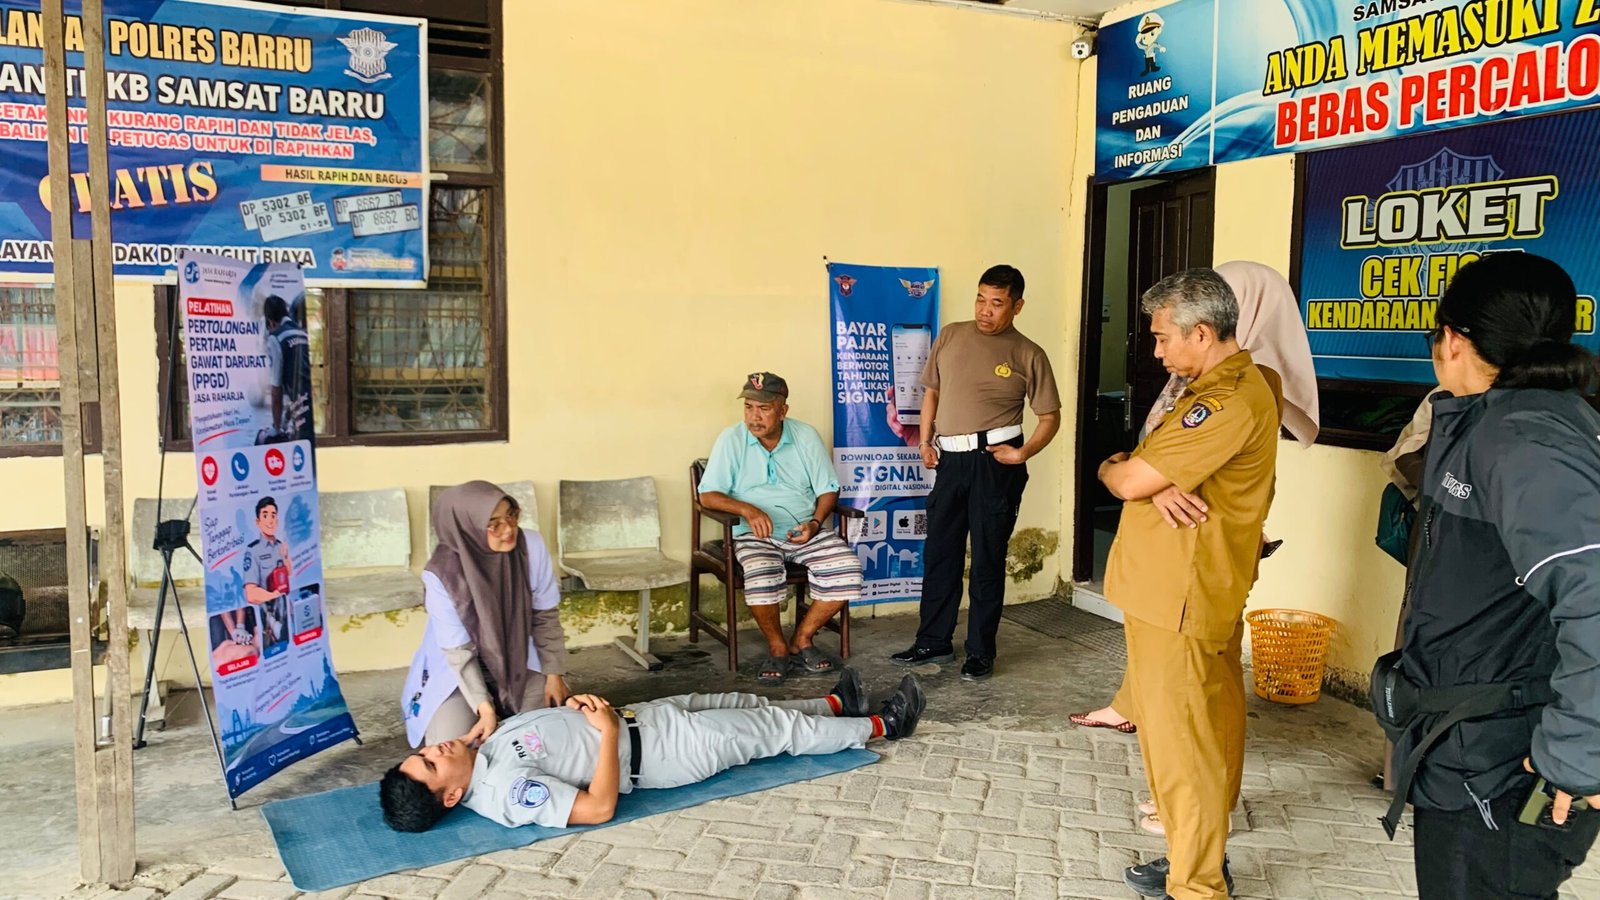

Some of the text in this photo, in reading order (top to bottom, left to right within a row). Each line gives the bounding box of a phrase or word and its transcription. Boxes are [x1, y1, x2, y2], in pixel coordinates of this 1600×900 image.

[1353, 0, 1433, 21] SAMS
[109, 20, 216, 64] POLRES
[220, 30, 312, 73] BARRU
[1264, 36, 1347, 95] ANDA
[1357, 0, 1560, 74] MEMASUKI
[65, 68, 150, 103] TKB
[158, 75, 282, 112] SAMSAT
[289, 87, 385, 120] BARRU
[1128, 76, 1172, 99] RUANG
[1275, 38, 1600, 146] BEBAS PERCALO
[1112, 96, 1189, 125] PENGADUAN
[0, 104, 377, 145] ETAK KURANG RAPIH DAN TIDAK JELAS,
[1135, 125, 1161, 142] DAN
[111, 130, 189, 148] PETUGAS
[194, 136, 253, 152] UNTUK
[256, 140, 270, 153] DI
[276, 142, 353, 158] RAPIHKAN
[1114, 144, 1183, 168] INFORMASI
[285, 168, 408, 185] HASIL RAPIH DAN BAGUS
[242, 193, 310, 216] DP 5302 BF
[335, 199, 349, 215] DP
[1344, 180, 1554, 246] LOKET
[258, 205, 326, 228] DP 5302 BF
[352, 214, 366, 228] DP
[404, 208, 418, 222] BC
[263, 249, 314, 266] BIAYA
[1361, 255, 1424, 298] CEK
[188, 300, 232, 314] PELATIHAN
[1308, 301, 1438, 330] KENDARAAN
[188, 319, 260, 335] PERTOLONGAN
[836, 321, 887, 336] BAYAR
[190, 337, 237, 352] PERTAMA
[836, 336, 888, 351] PAJAK
[191, 355, 266, 369] GAWAT DARURAT
[836, 352, 889, 361] KENDARAAN
[836, 361, 889, 371] BERMOTOR
[192, 372, 230, 391] (PPGD)
[837, 371, 890, 381] TAHUNAN
[837, 382, 890, 391] DI APLIKASI
[194, 391, 245, 403] JASA RAHARJA
[837, 391, 892, 404] SIGNAL
[840, 453, 923, 462] DOWNLOAD SEKARA
[853, 465, 924, 483] SIGNAL
[875, 484, 901, 492] DIGITAL
[903, 483, 933, 491] NASIONAL
